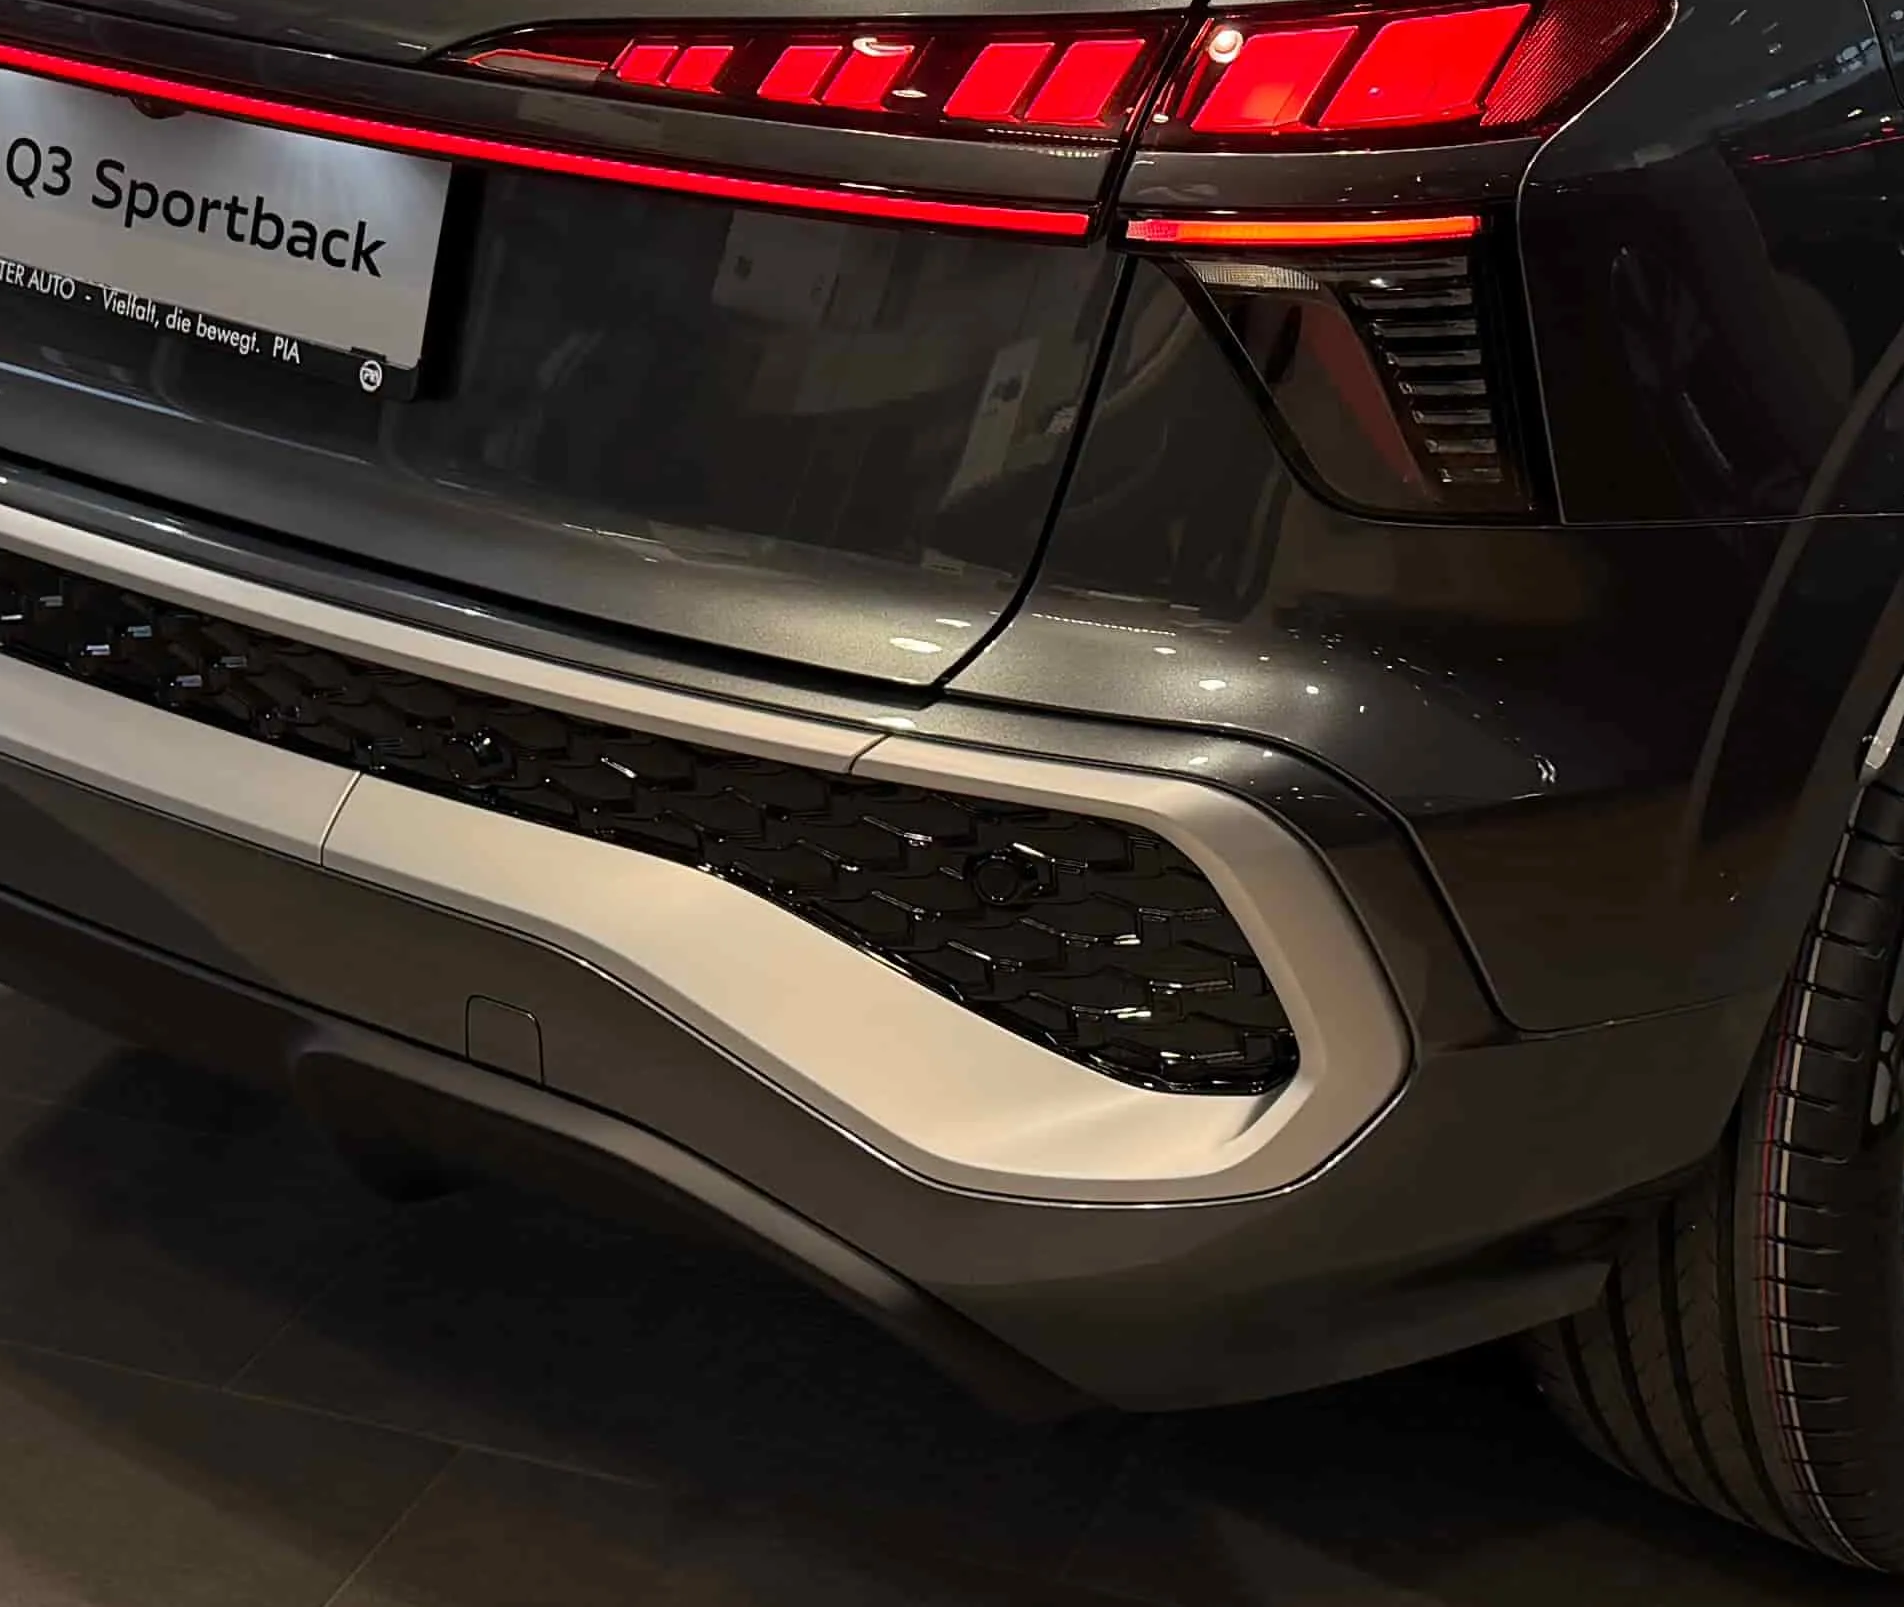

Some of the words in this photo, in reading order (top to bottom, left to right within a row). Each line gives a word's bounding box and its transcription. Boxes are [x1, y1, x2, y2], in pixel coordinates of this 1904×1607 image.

[5, 137, 73, 198] Q3
[91, 159, 387, 278] Sportback
[27, 269, 76, 300] AUTO
[102, 286, 159, 329] Vielfalt,
[165, 306, 192, 333] die
[196, 313, 260, 355] bewegt.
[272, 336, 301, 364] PIA
